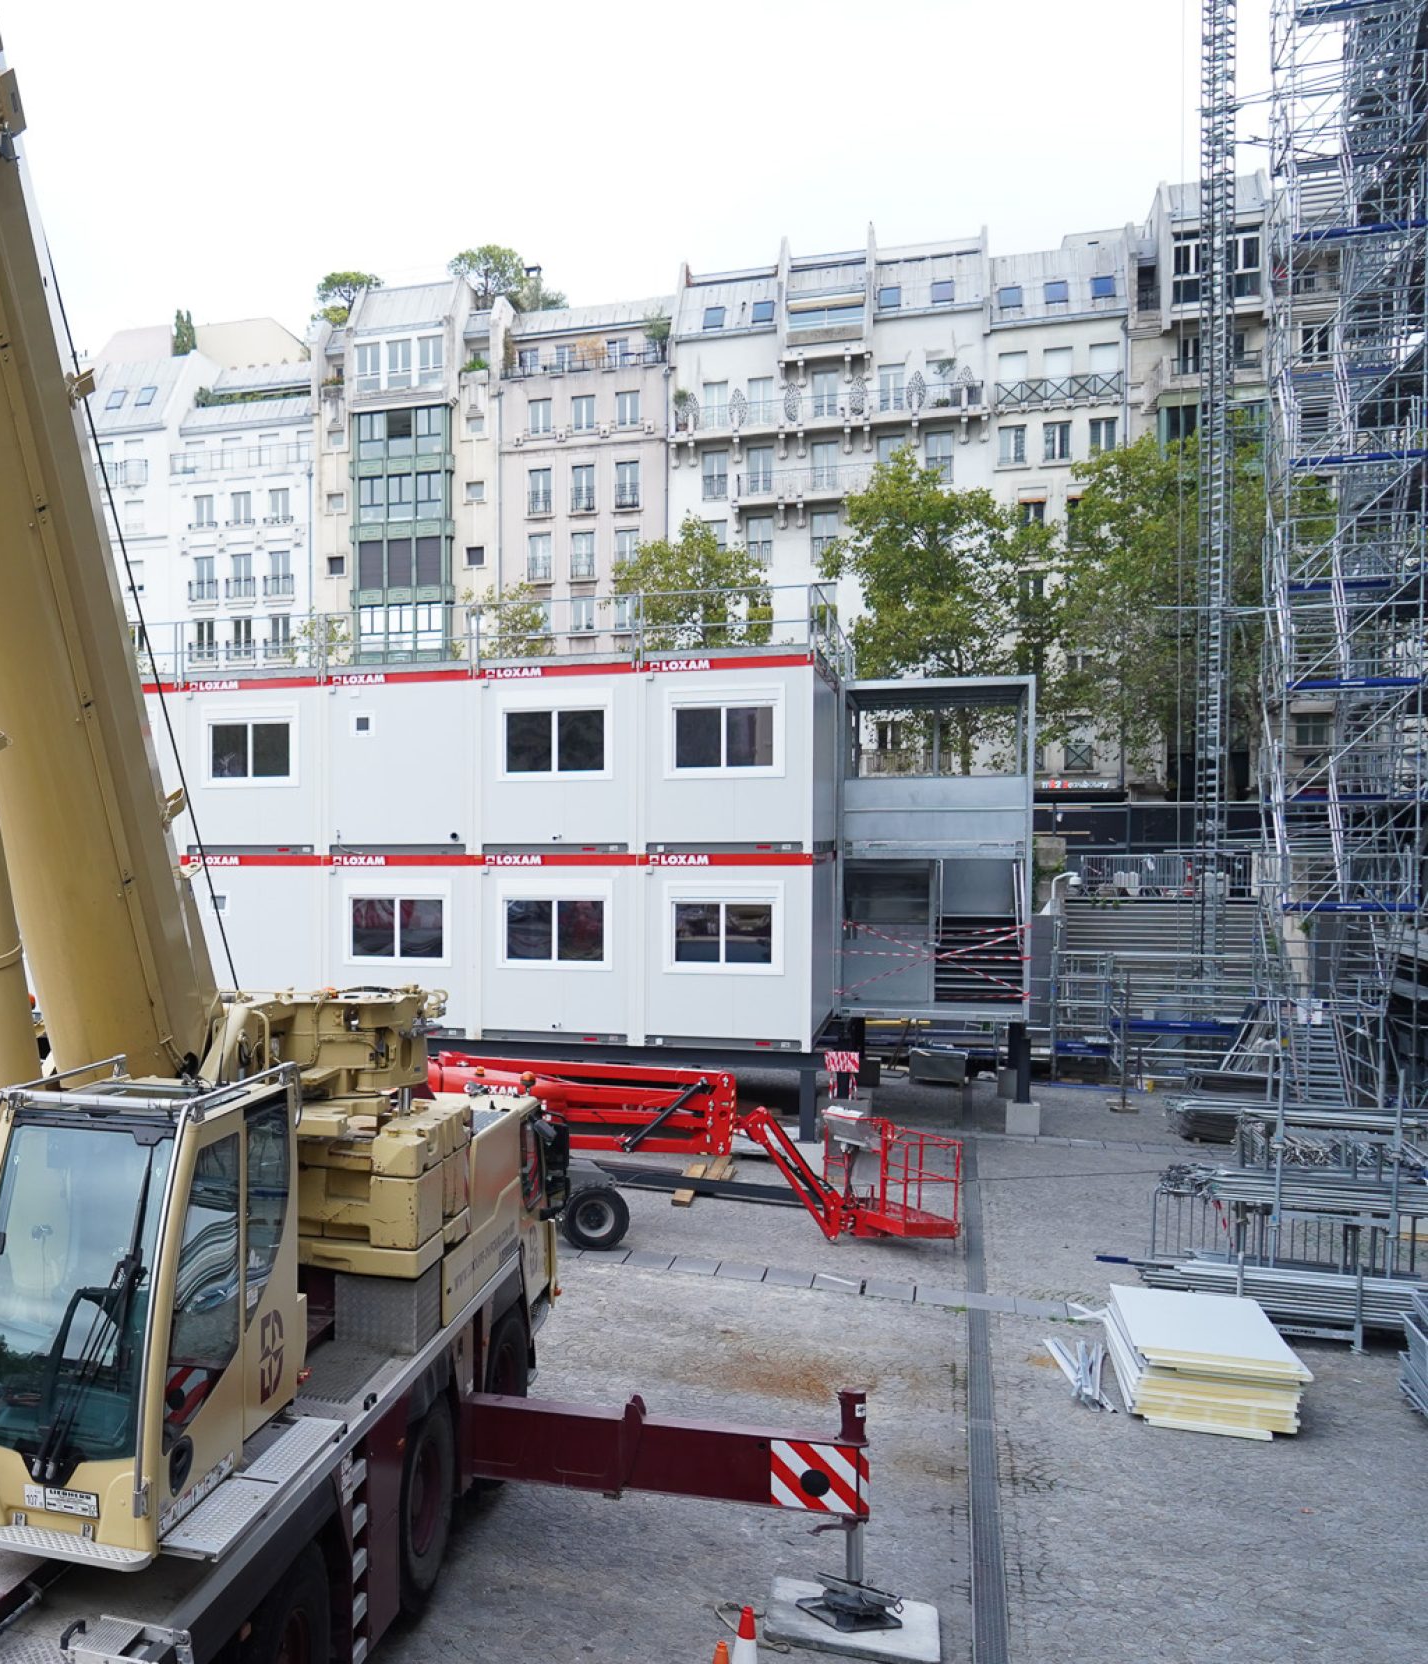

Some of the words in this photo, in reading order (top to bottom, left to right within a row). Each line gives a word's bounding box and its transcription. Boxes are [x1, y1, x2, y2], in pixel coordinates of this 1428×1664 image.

[661, 659, 710, 671] LOXAM
[342, 673, 385, 685] LOXAM
[496, 667, 542, 679] LOXAM
[199, 680, 239, 691] LOXAM
[342, 855, 386, 866] LOXAM
[496, 855, 542, 866] LOXAM
[661, 854, 709, 866] LOXAM
